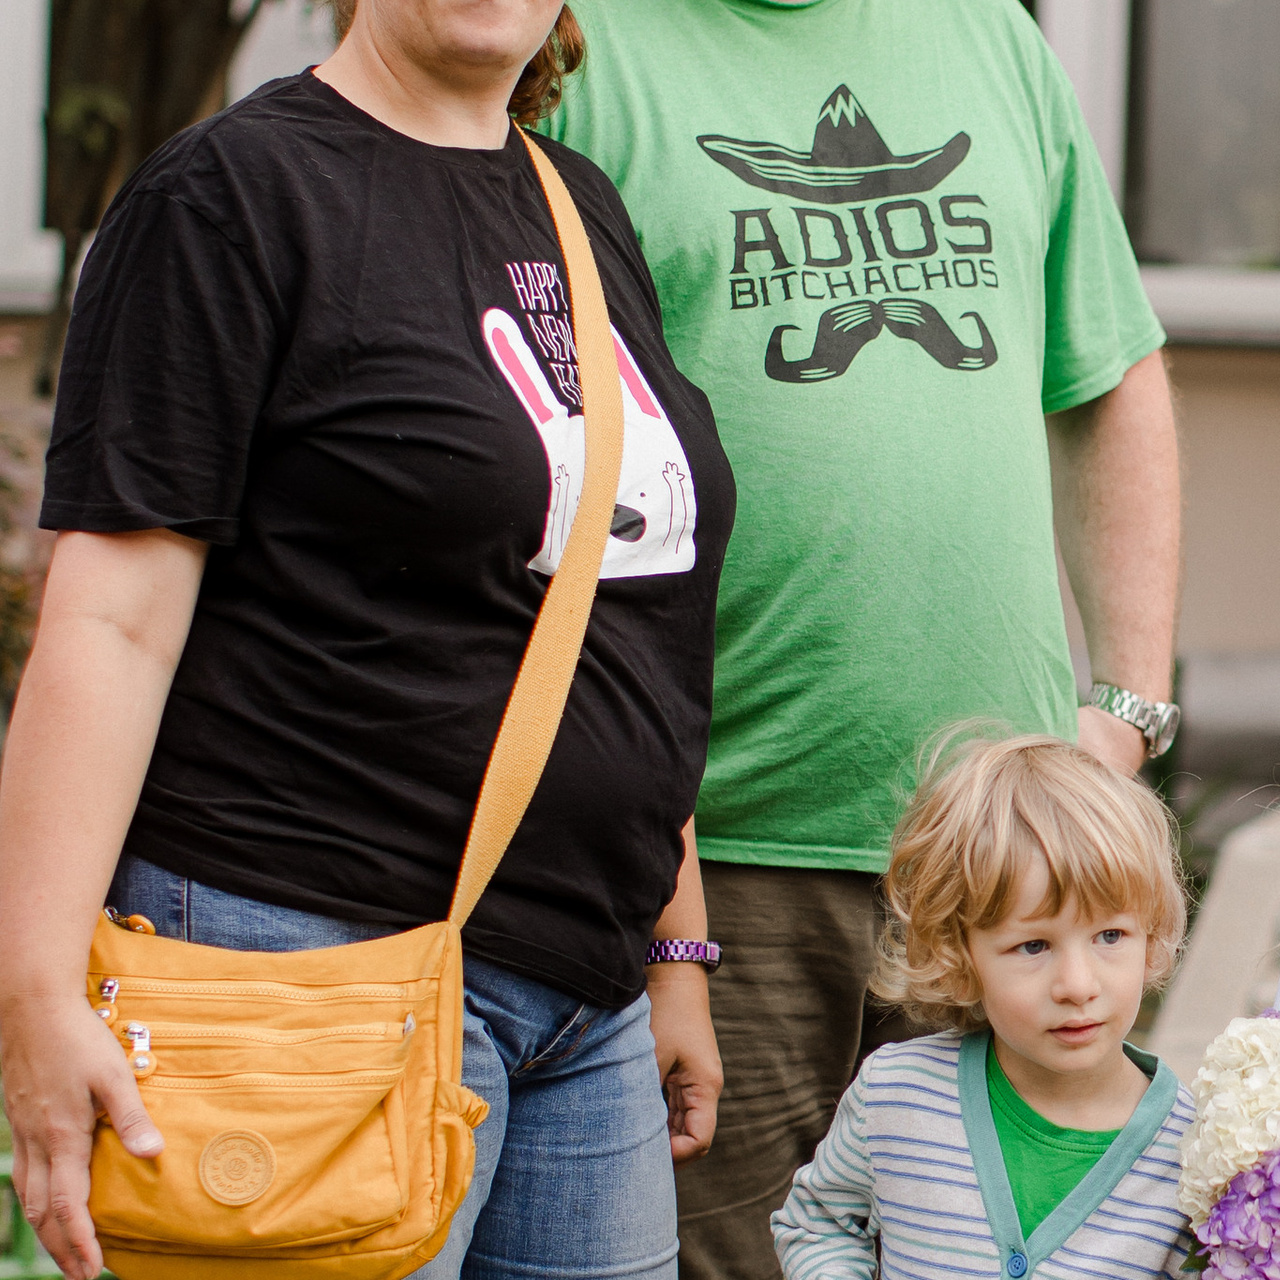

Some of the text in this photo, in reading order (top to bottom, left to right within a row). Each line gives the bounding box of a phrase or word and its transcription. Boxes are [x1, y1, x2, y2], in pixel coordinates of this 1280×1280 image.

[729, 195, 993, 274] ADIOS
[504, 261, 569, 312] HAPPY
[729, 258, 999, 310] BITCHACHOS
[526, 312, 579, 362] NEW
